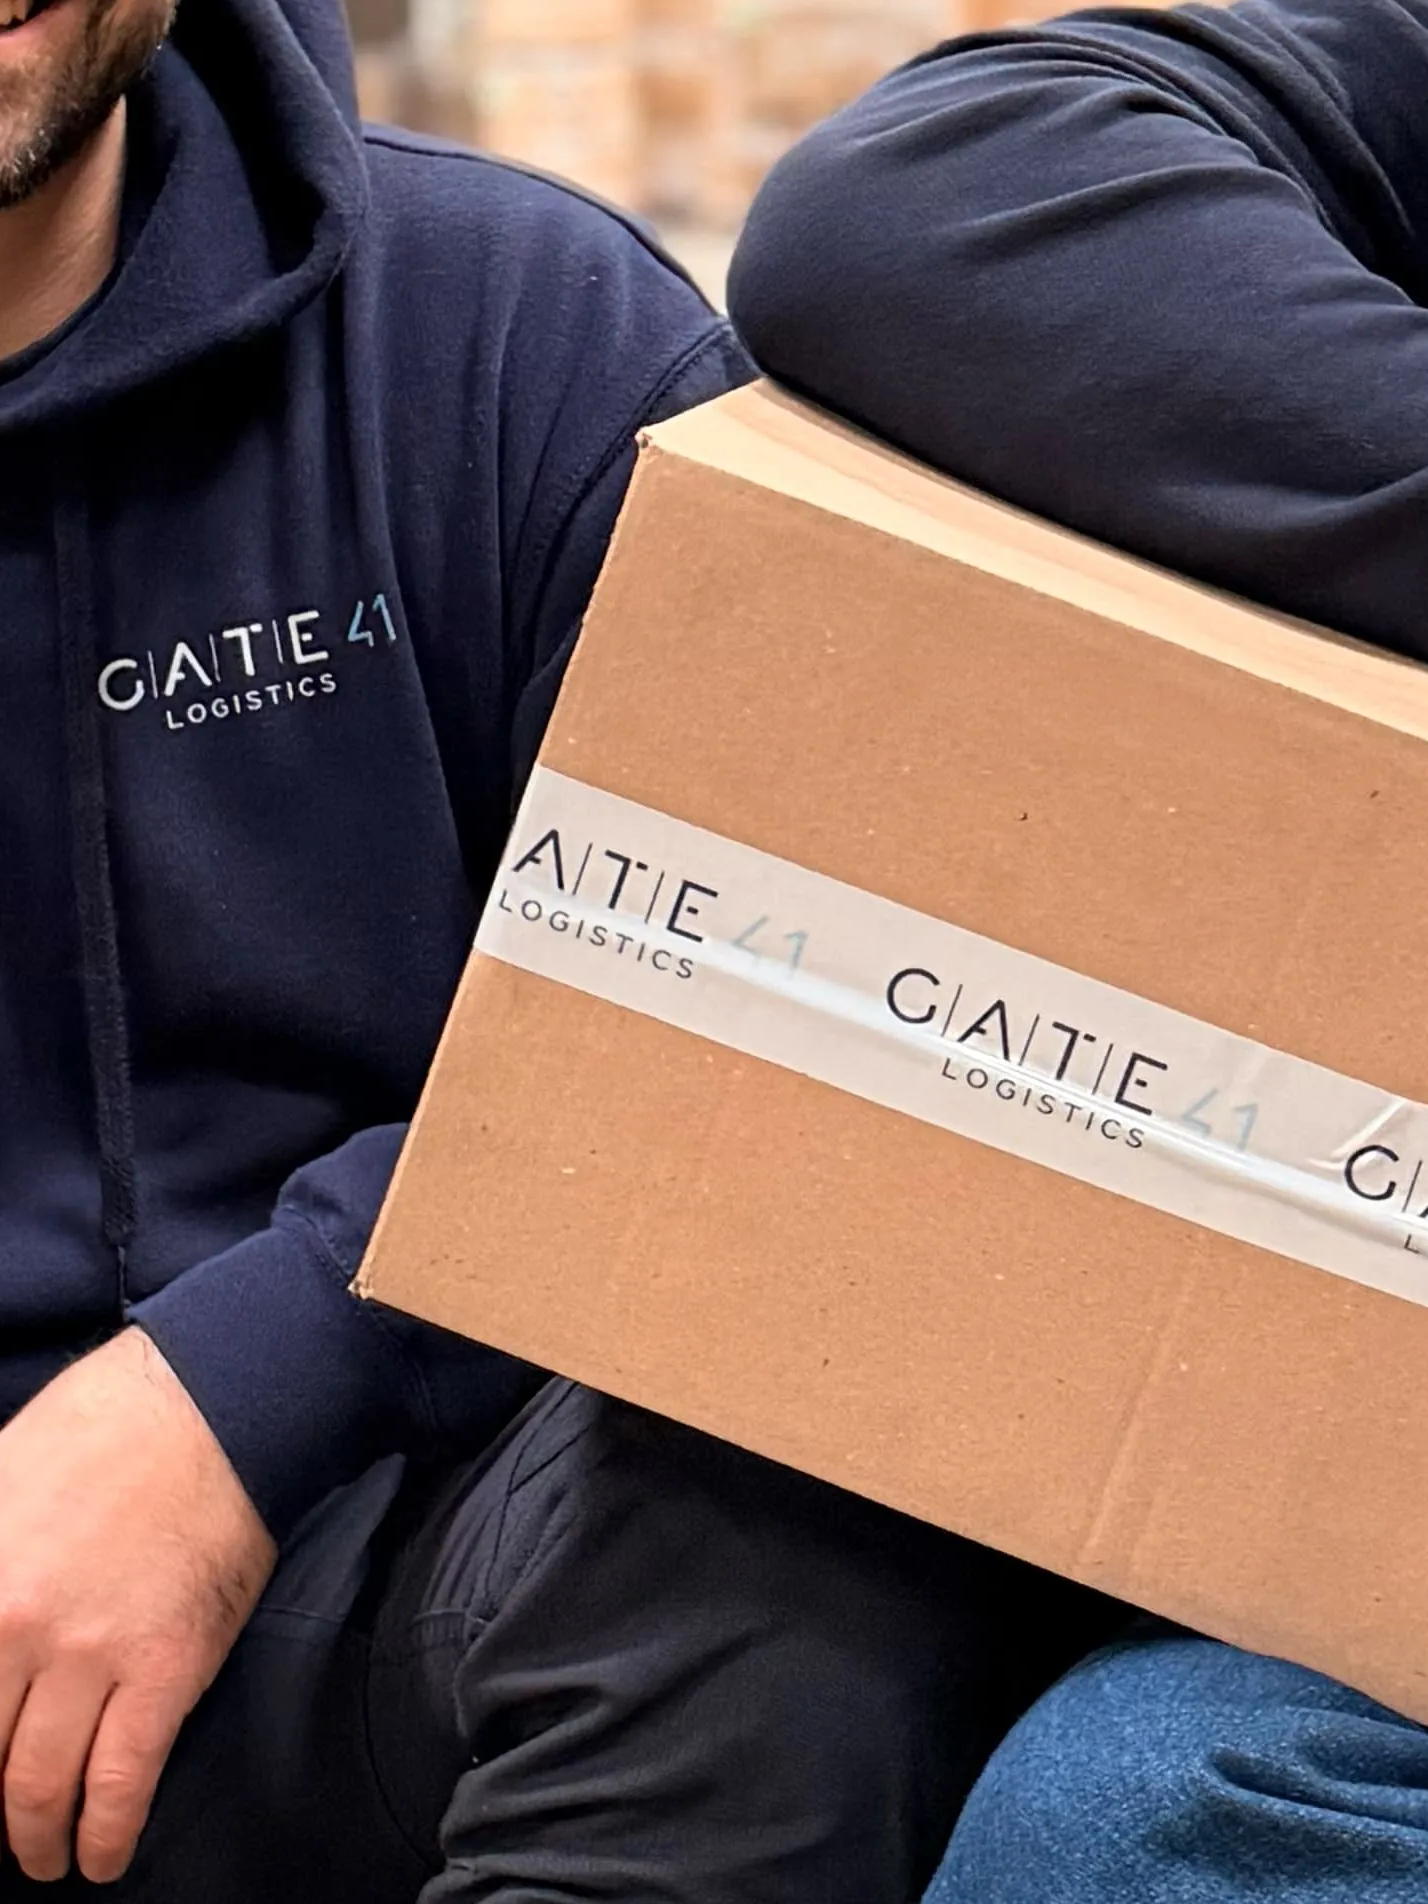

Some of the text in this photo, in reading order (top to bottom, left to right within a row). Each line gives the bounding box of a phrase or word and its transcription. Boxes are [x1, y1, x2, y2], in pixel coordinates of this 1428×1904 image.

[346, 593, 397, 647] 41
[166, 672, 337, 730] LOGISTICS
[497, 890, 695, 980] LOGISTICS
[511, 829, 810, 982] ATE 41
[940, 1057, 1146, 1150] LOGISTICS
[1179, 1087, 1260, 1154] 41
